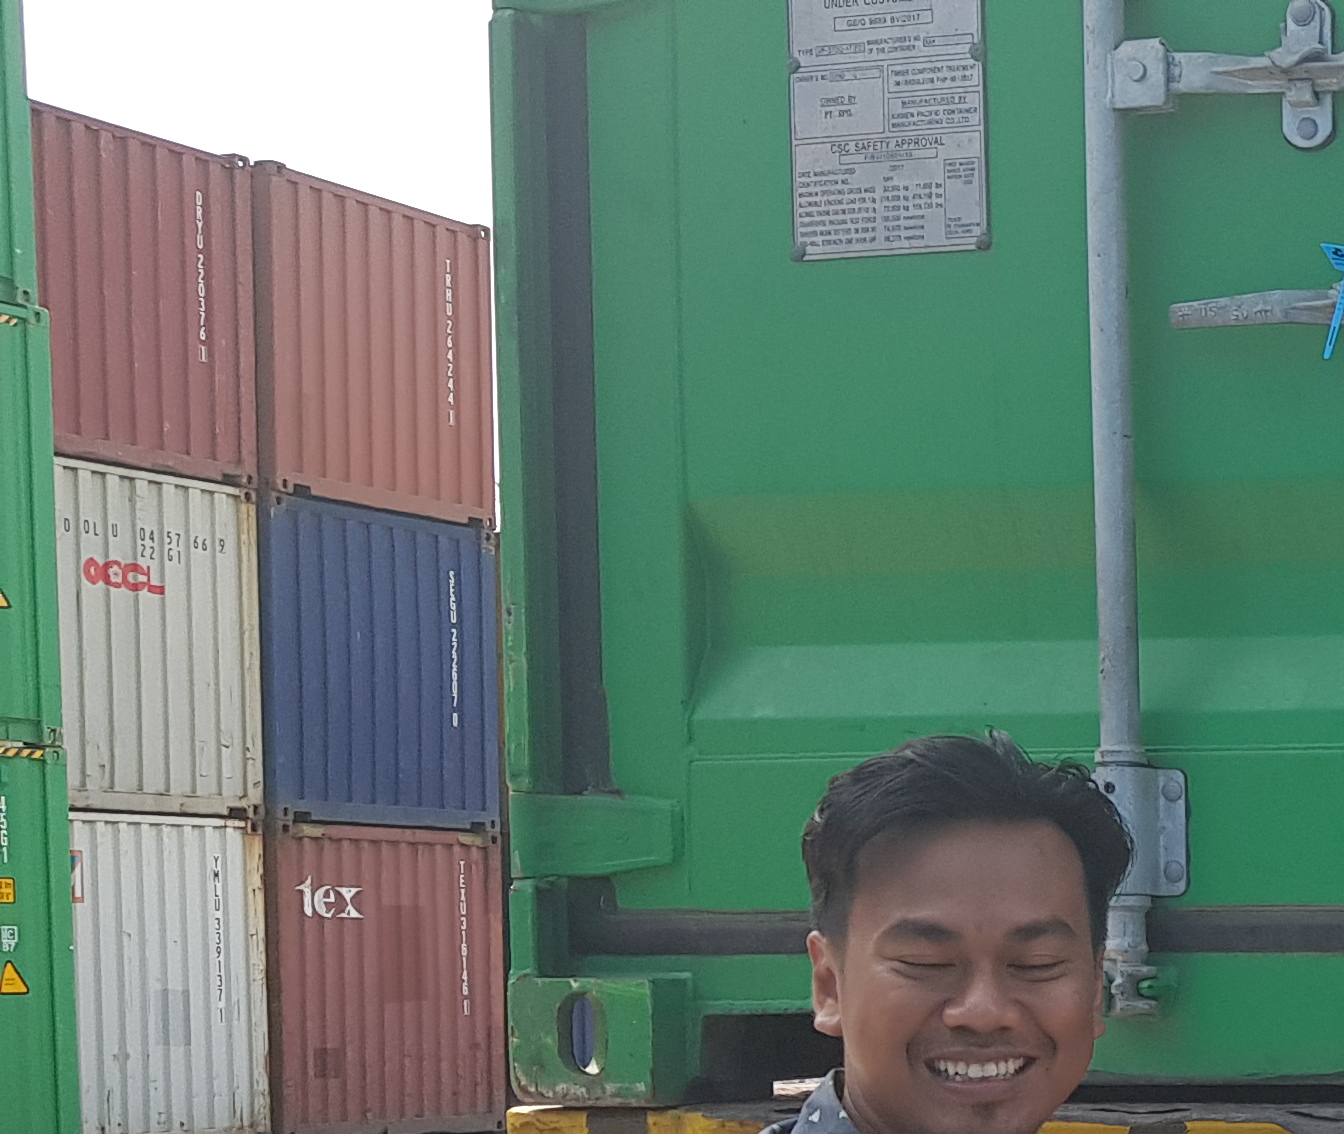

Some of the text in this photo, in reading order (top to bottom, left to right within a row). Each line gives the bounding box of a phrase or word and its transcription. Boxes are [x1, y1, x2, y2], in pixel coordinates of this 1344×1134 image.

[830, 136, 945, 154] CSC SAFETY APPROVAL
[196, 191, 204, 249] DRYU
[197, 254, 206, 341] 220376
[446, 320, 454, 405] 264244
[294, 875, 365, 919] tex
[459, 861, 467, 915] TEXU
[215, 918, 223, 1002] 339137
[460, 917, 469, 995] 316146
